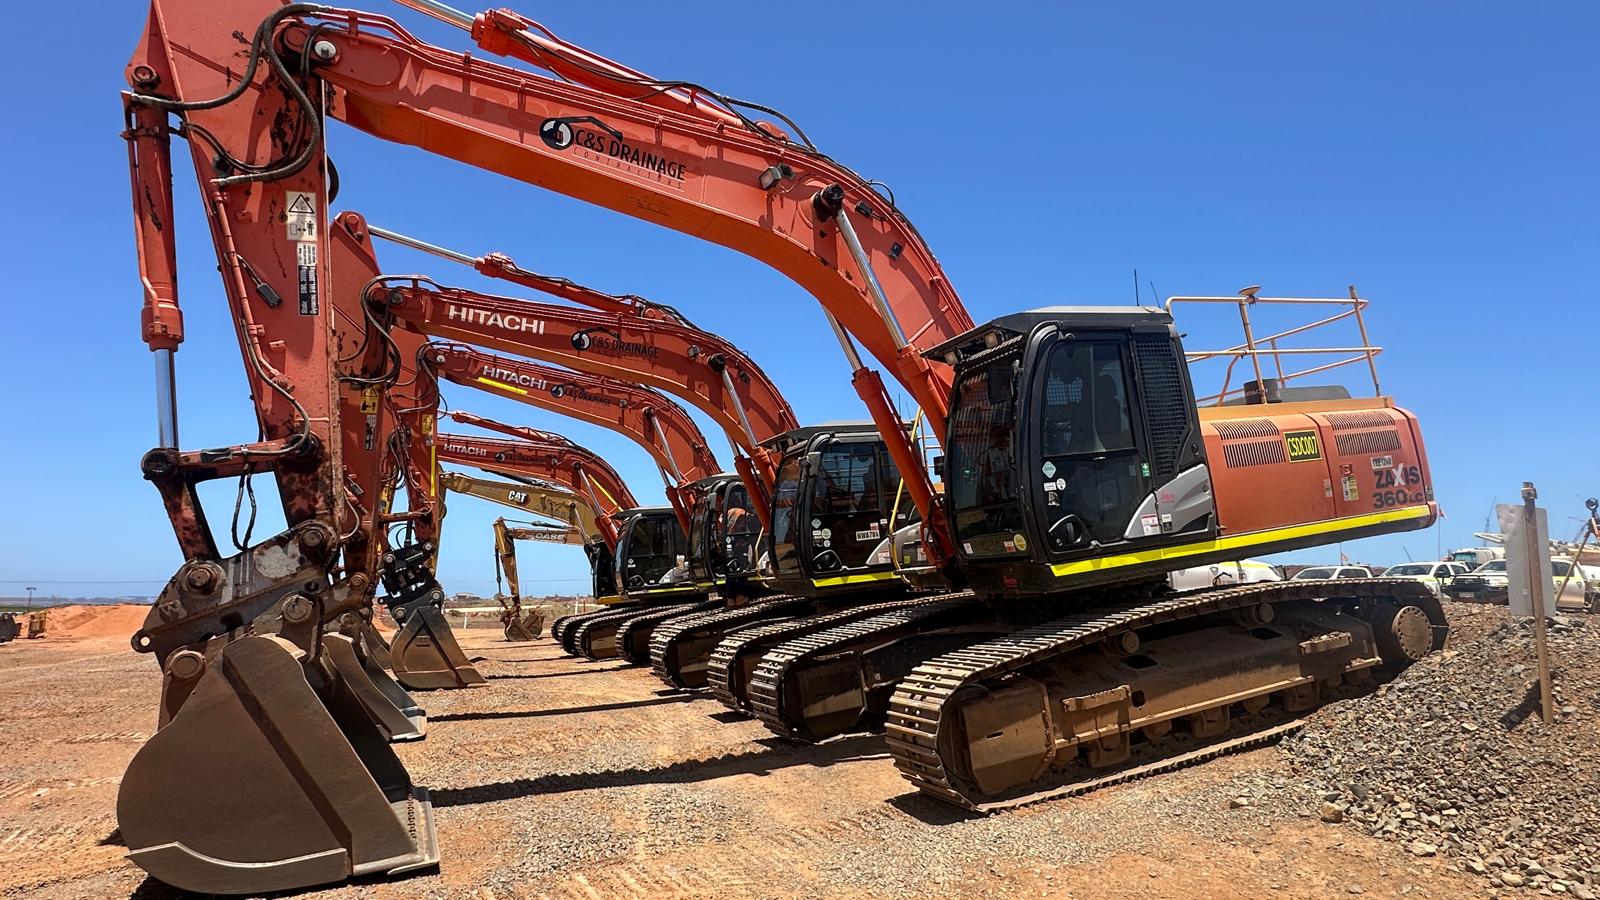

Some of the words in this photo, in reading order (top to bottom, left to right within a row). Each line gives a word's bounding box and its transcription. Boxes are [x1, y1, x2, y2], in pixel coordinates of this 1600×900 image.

[575, 129, 606, 153] C&S
[609, 141, 686, 181] DRAINAGE
[573, 147, 682, 190] CONTRACTORS
[448, 305, 545, 335] HITACHI
[591, 336, 609, 349] C&S
[612, 338, 659, 358] DRAINAGE
[483, 366, 546, 389] HITACHI
[444, 443, 487, 457] HITACHI
[1287, 435, 1318, 457] CSDC007
[1374, 463, 1421, 489] ZAXIS
[508, 490, 527, 503] CAT
[534, 533, 566, 541] CASE
